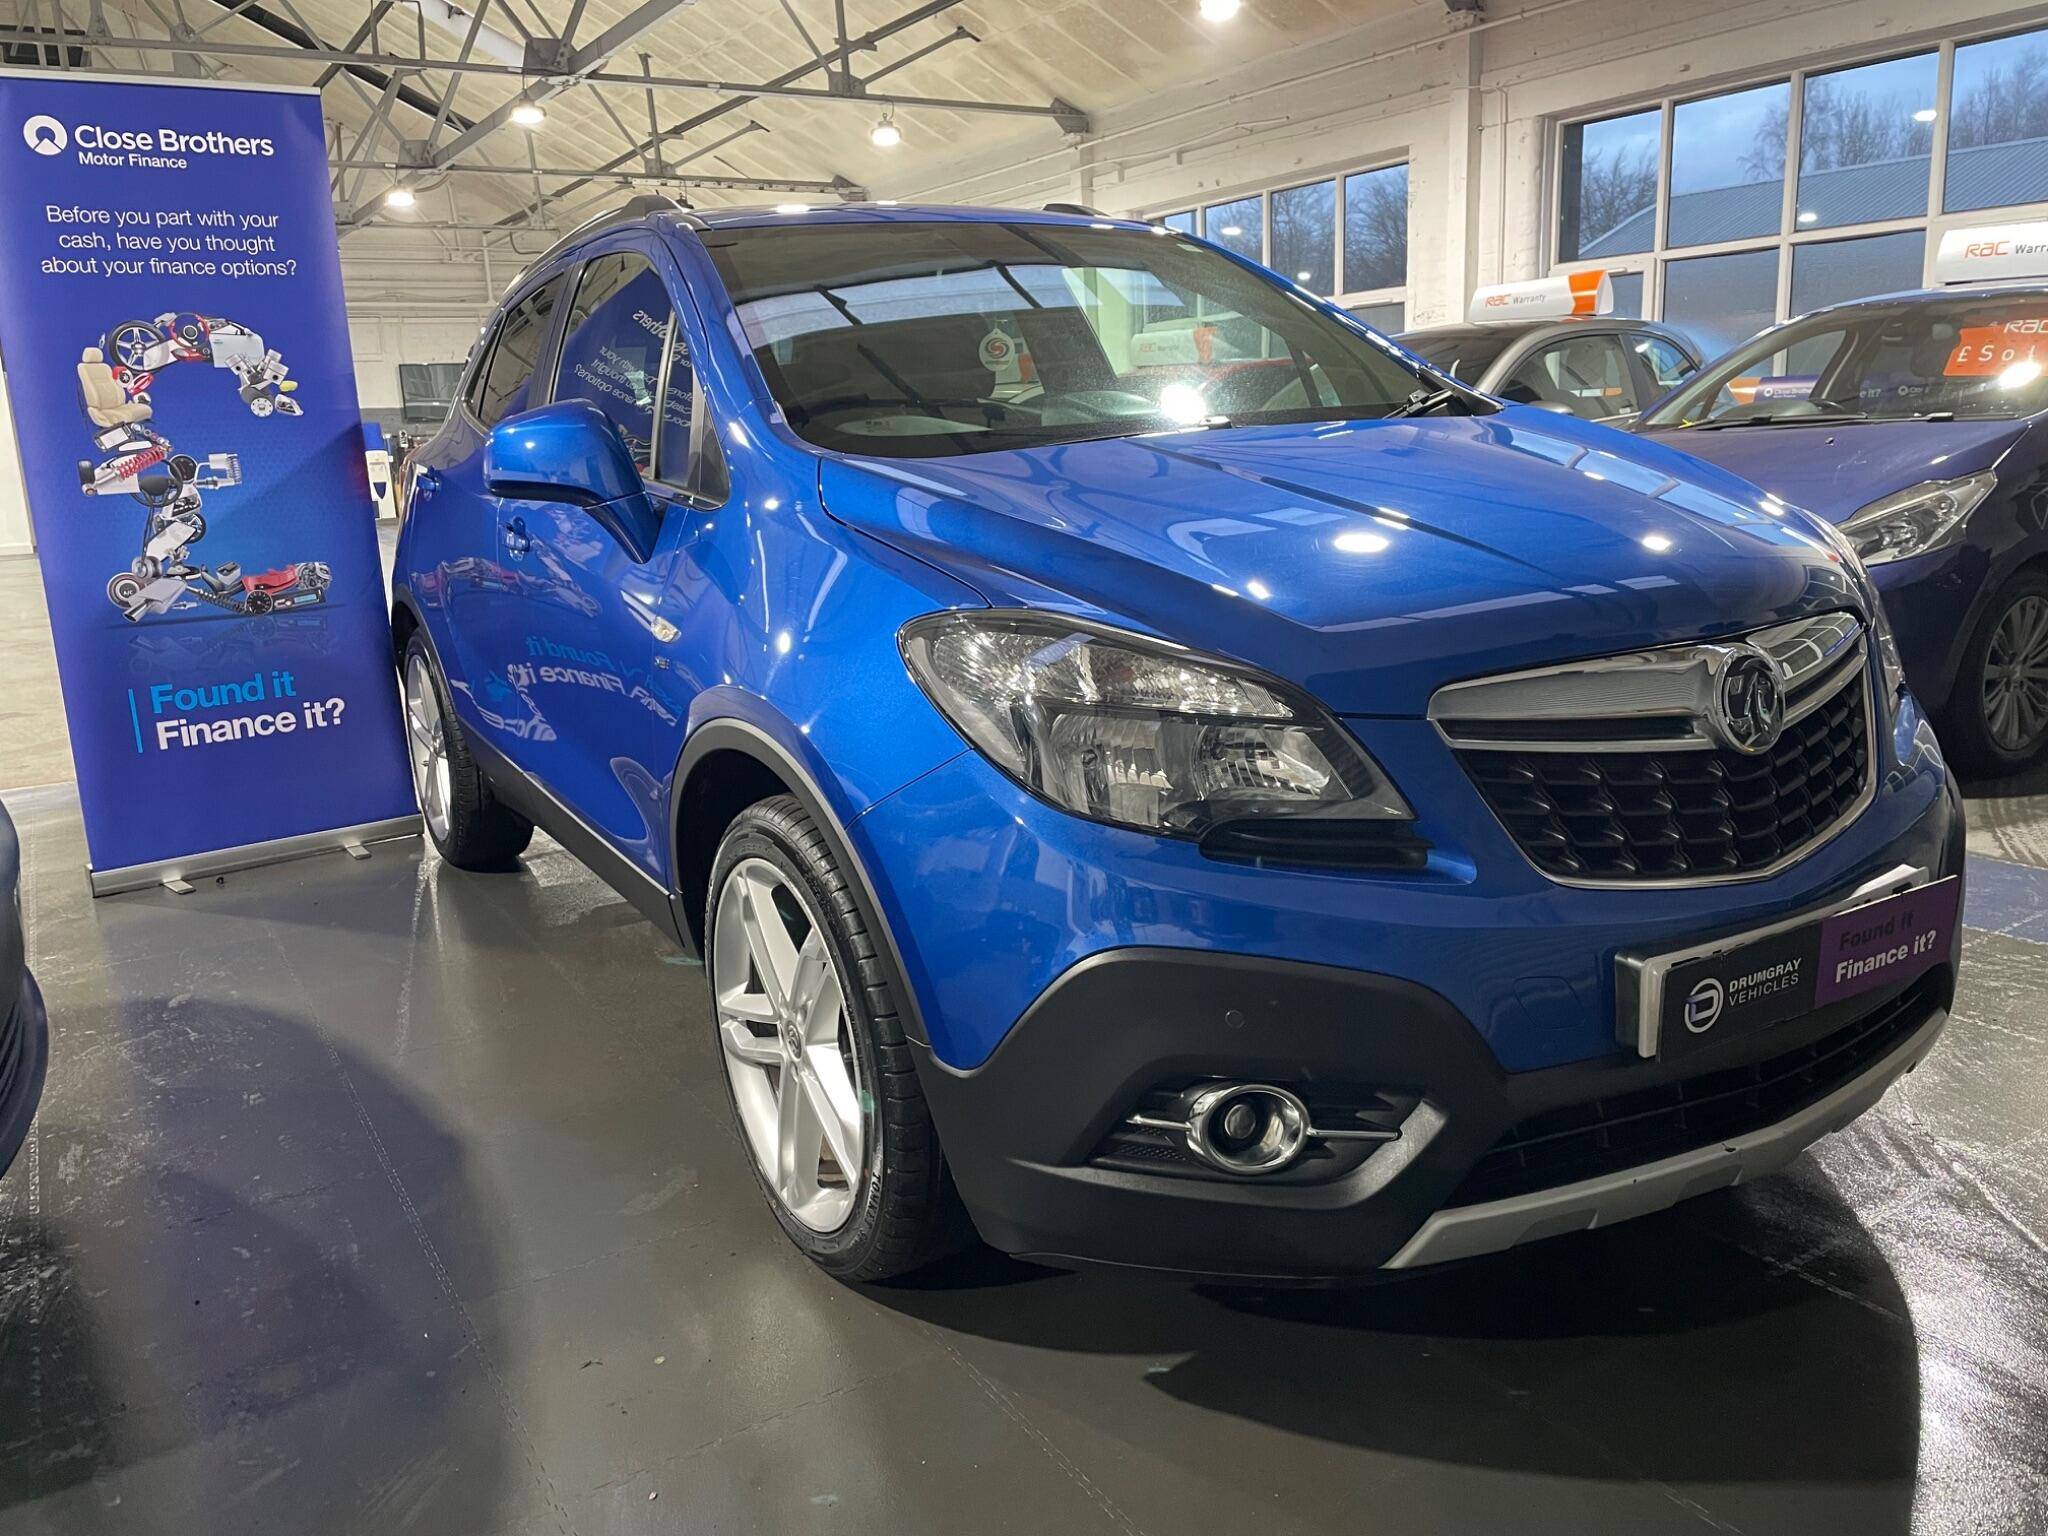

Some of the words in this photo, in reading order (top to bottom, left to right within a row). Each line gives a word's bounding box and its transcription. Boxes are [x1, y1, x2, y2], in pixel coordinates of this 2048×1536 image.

[74, 124, 153, 150] Close
[158, 128, 275, 156] Brothers
[78, 151, 124, 167] Motor
[129, 153, 187, 169] Finance
[46, 205, 110, 224] Before
[114, 211, 150, 227] you
[156, 210, 192, 229] part
[197, 210, 235, 227] with
[239, 214, 279, 231] your
[59, 231, 111, 251] cash,
[116, 232, 162, 250] have
[166, 236, 201, 253] you
[205, 235, 276, 255] thought
[2015, 244, 2048, 255] Warr
[41, 256, 98, 274] about
[102, 260, 145, 278] your
[149, 258, 216, 276] finance
[221, 259, 298, 279] options?
[1513, 294, 1547, 305] Warranty
[150, 673, 265, 714] Found
[271, 671, 296, 698] it
[156, 711, 297, 750] Finance
[303, 697, 345, 729] it?
[1839, 918, 1895, 951] Found
[1899, 910, 1914, 929] it
[1835, 944, 1908, 984] Finance
[1913, 929, 1937, 955] it?
[1729, 958, 1801, 993] DRUMGRAY
[1729, 973, 1799, 1006] VEHICLES
